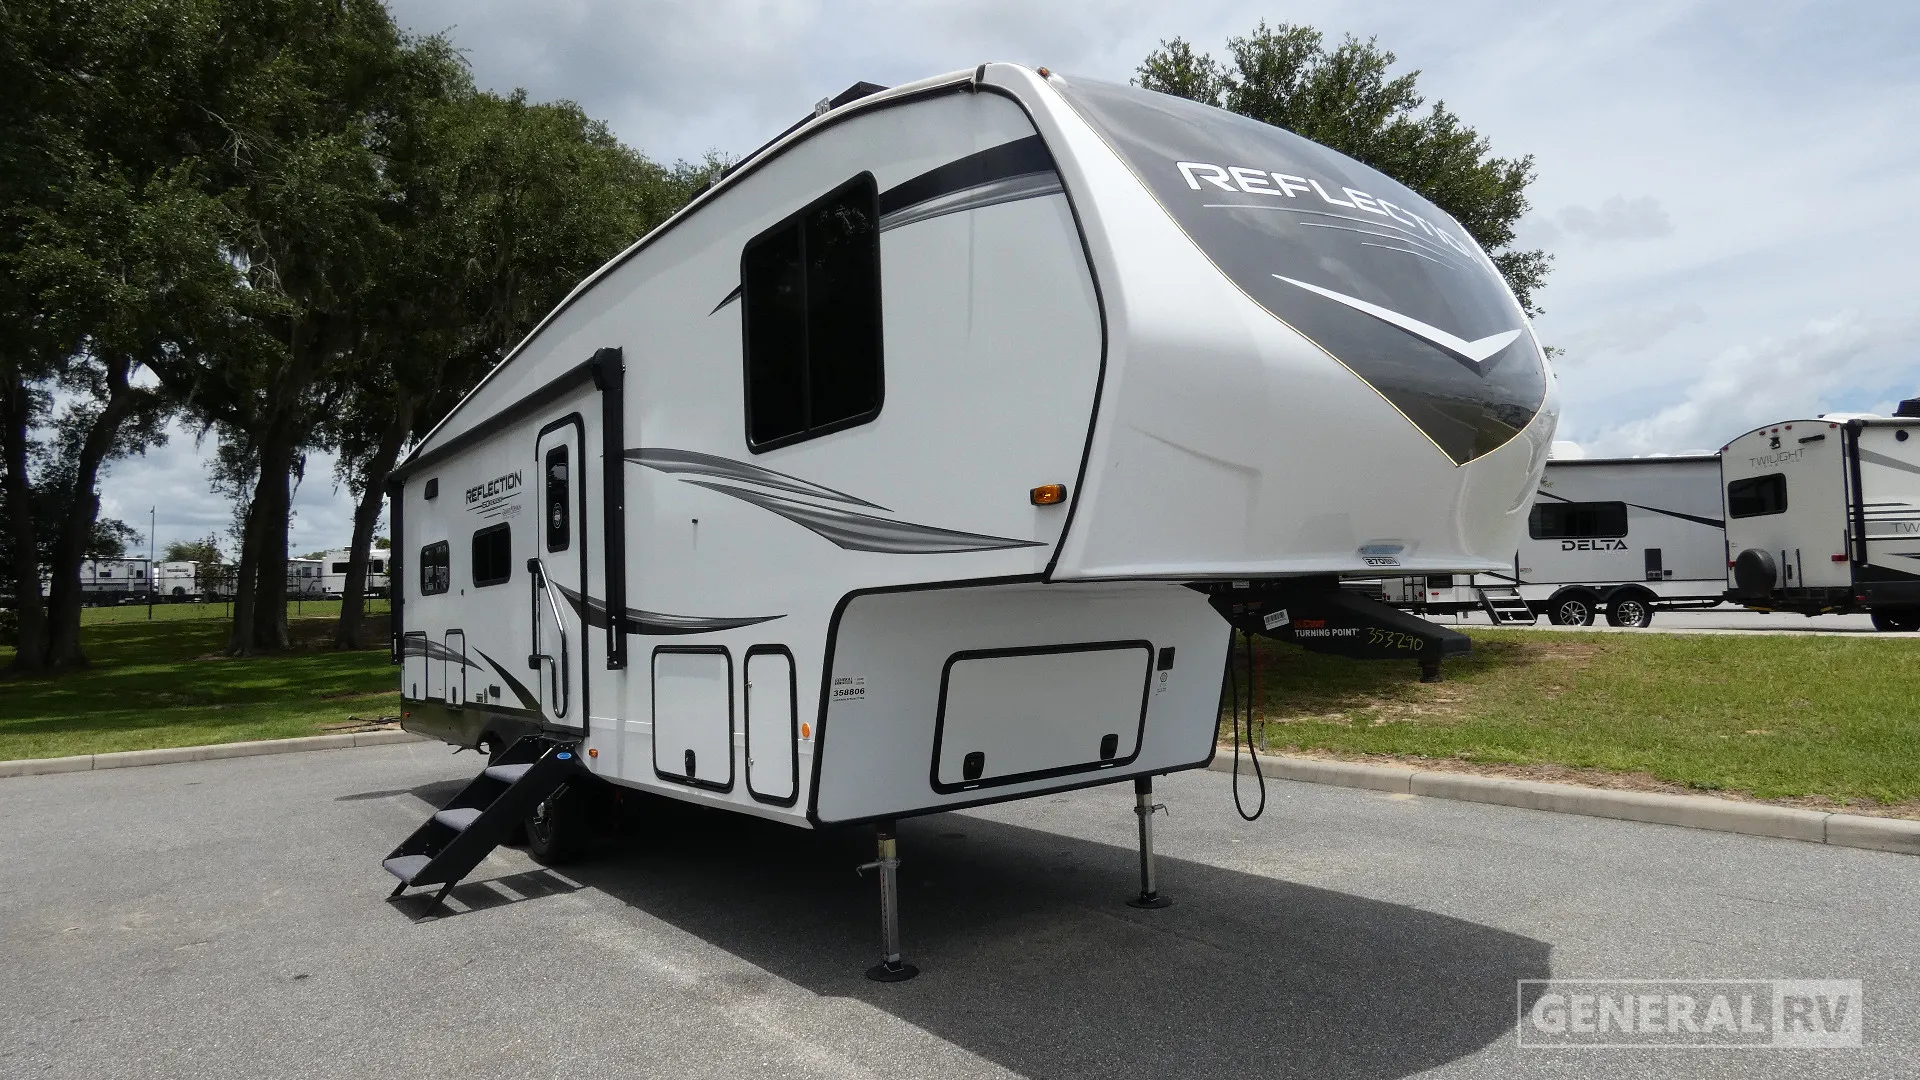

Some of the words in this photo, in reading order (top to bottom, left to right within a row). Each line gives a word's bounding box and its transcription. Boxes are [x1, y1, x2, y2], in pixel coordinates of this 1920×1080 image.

[1176, 161, 1491, 274] REFLECTION
[1749, 448, 1805, 466] TWILIGHT
[466, 469, 522, 504] REFLECTION
[1562, 539, 1628, 551] DELTA
[1295, 628, 1330, 638] TURNING
[1332, 628, 1357, 637] POINT
[1366, 627, 1424, 650] 353290
